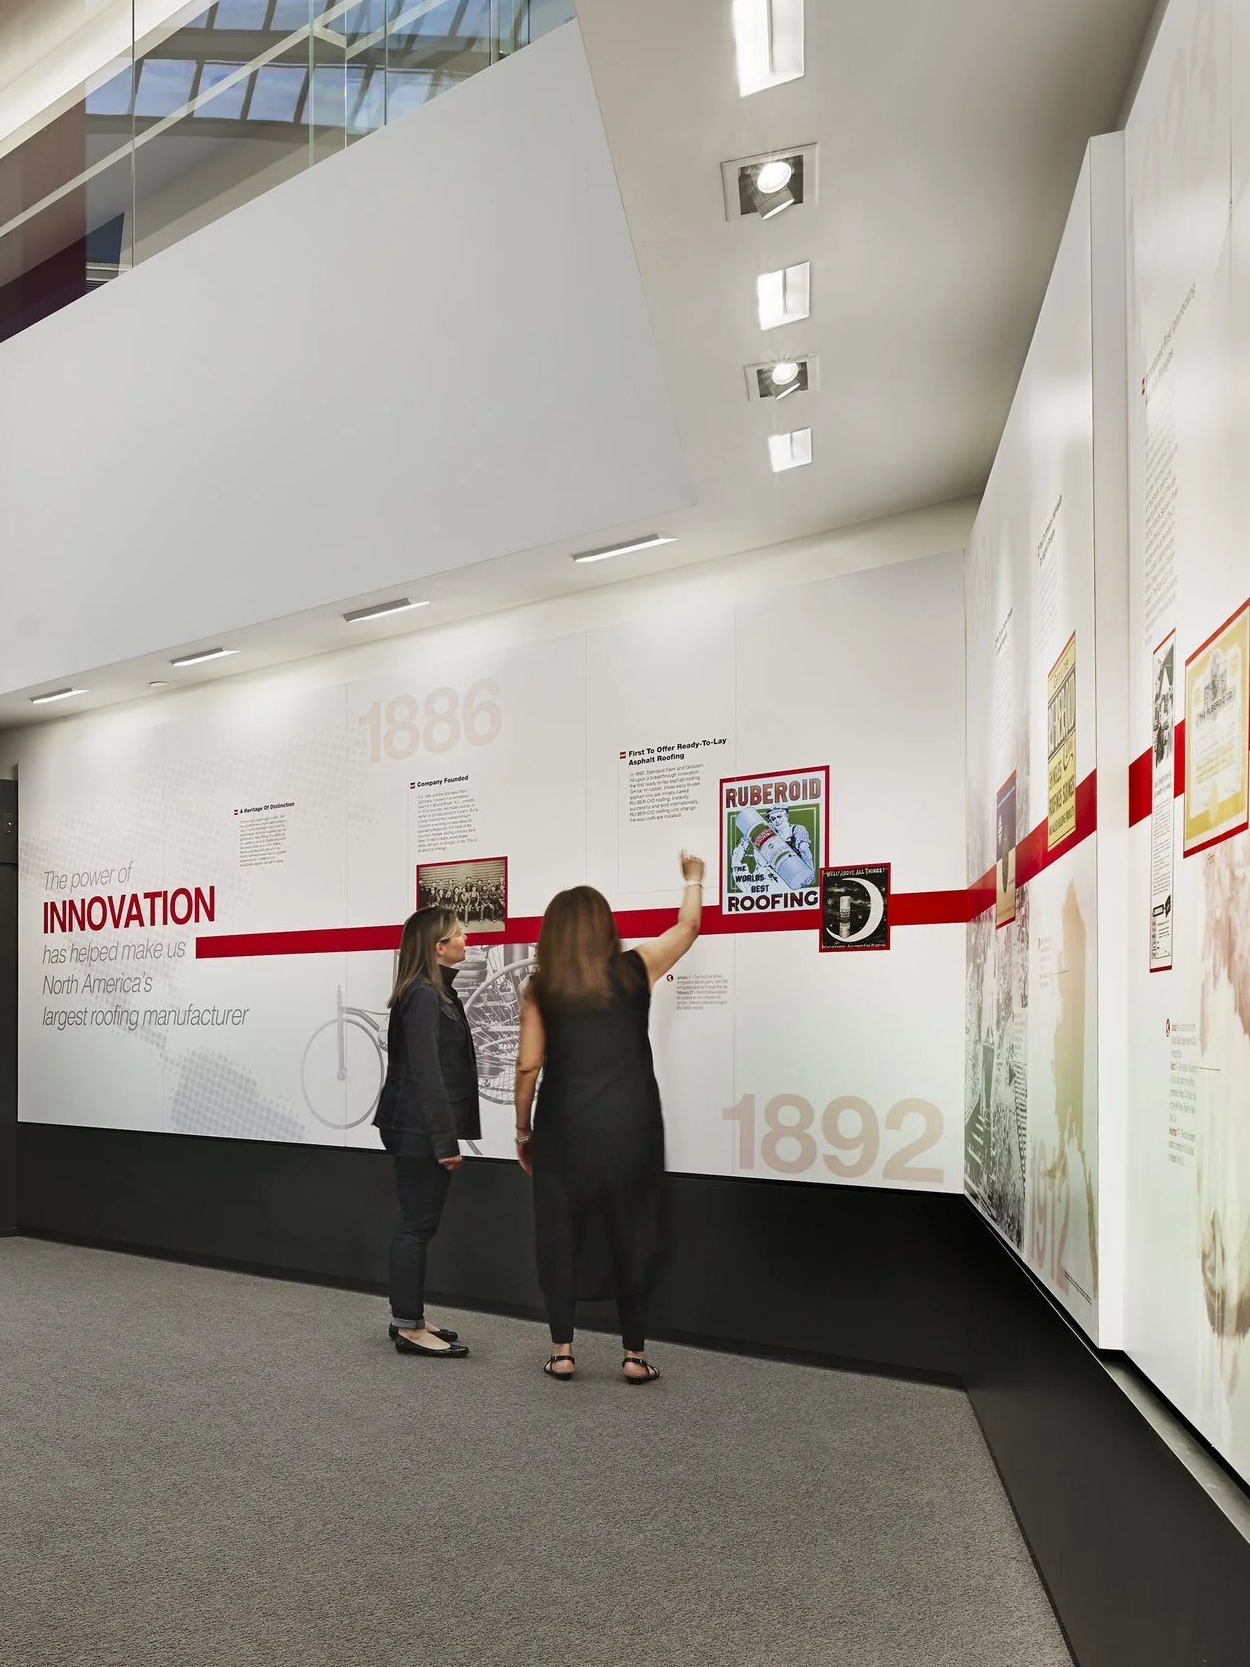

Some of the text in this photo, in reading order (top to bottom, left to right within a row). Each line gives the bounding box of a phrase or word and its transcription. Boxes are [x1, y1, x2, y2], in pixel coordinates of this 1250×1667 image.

[359, 678, 502, 764] 1886
[629, 749, 644, 757] First
[657, 745, 675, 753] Offer
[677, 738, 727, 750] Ready-To-Lay
[629, 753, 685, 766] Asphalt Roofing
[444, 775, 468, 783] Founded
[726, 778, 822, 808] RUBEROID
[44, 861, 134, 893] The power of
[751, 885, 769, 893] BEST
[44, 886, 215, 934] INNOVATION
[728, 891, 818, 912] ROOFING
[43, 938, 186, 967] has helped make us
[43, 971, 153, 995] North America's
[42, 1004, 250, 1031] largest roofing manufacturer
[722, 1093, 944, 1184] 1892
